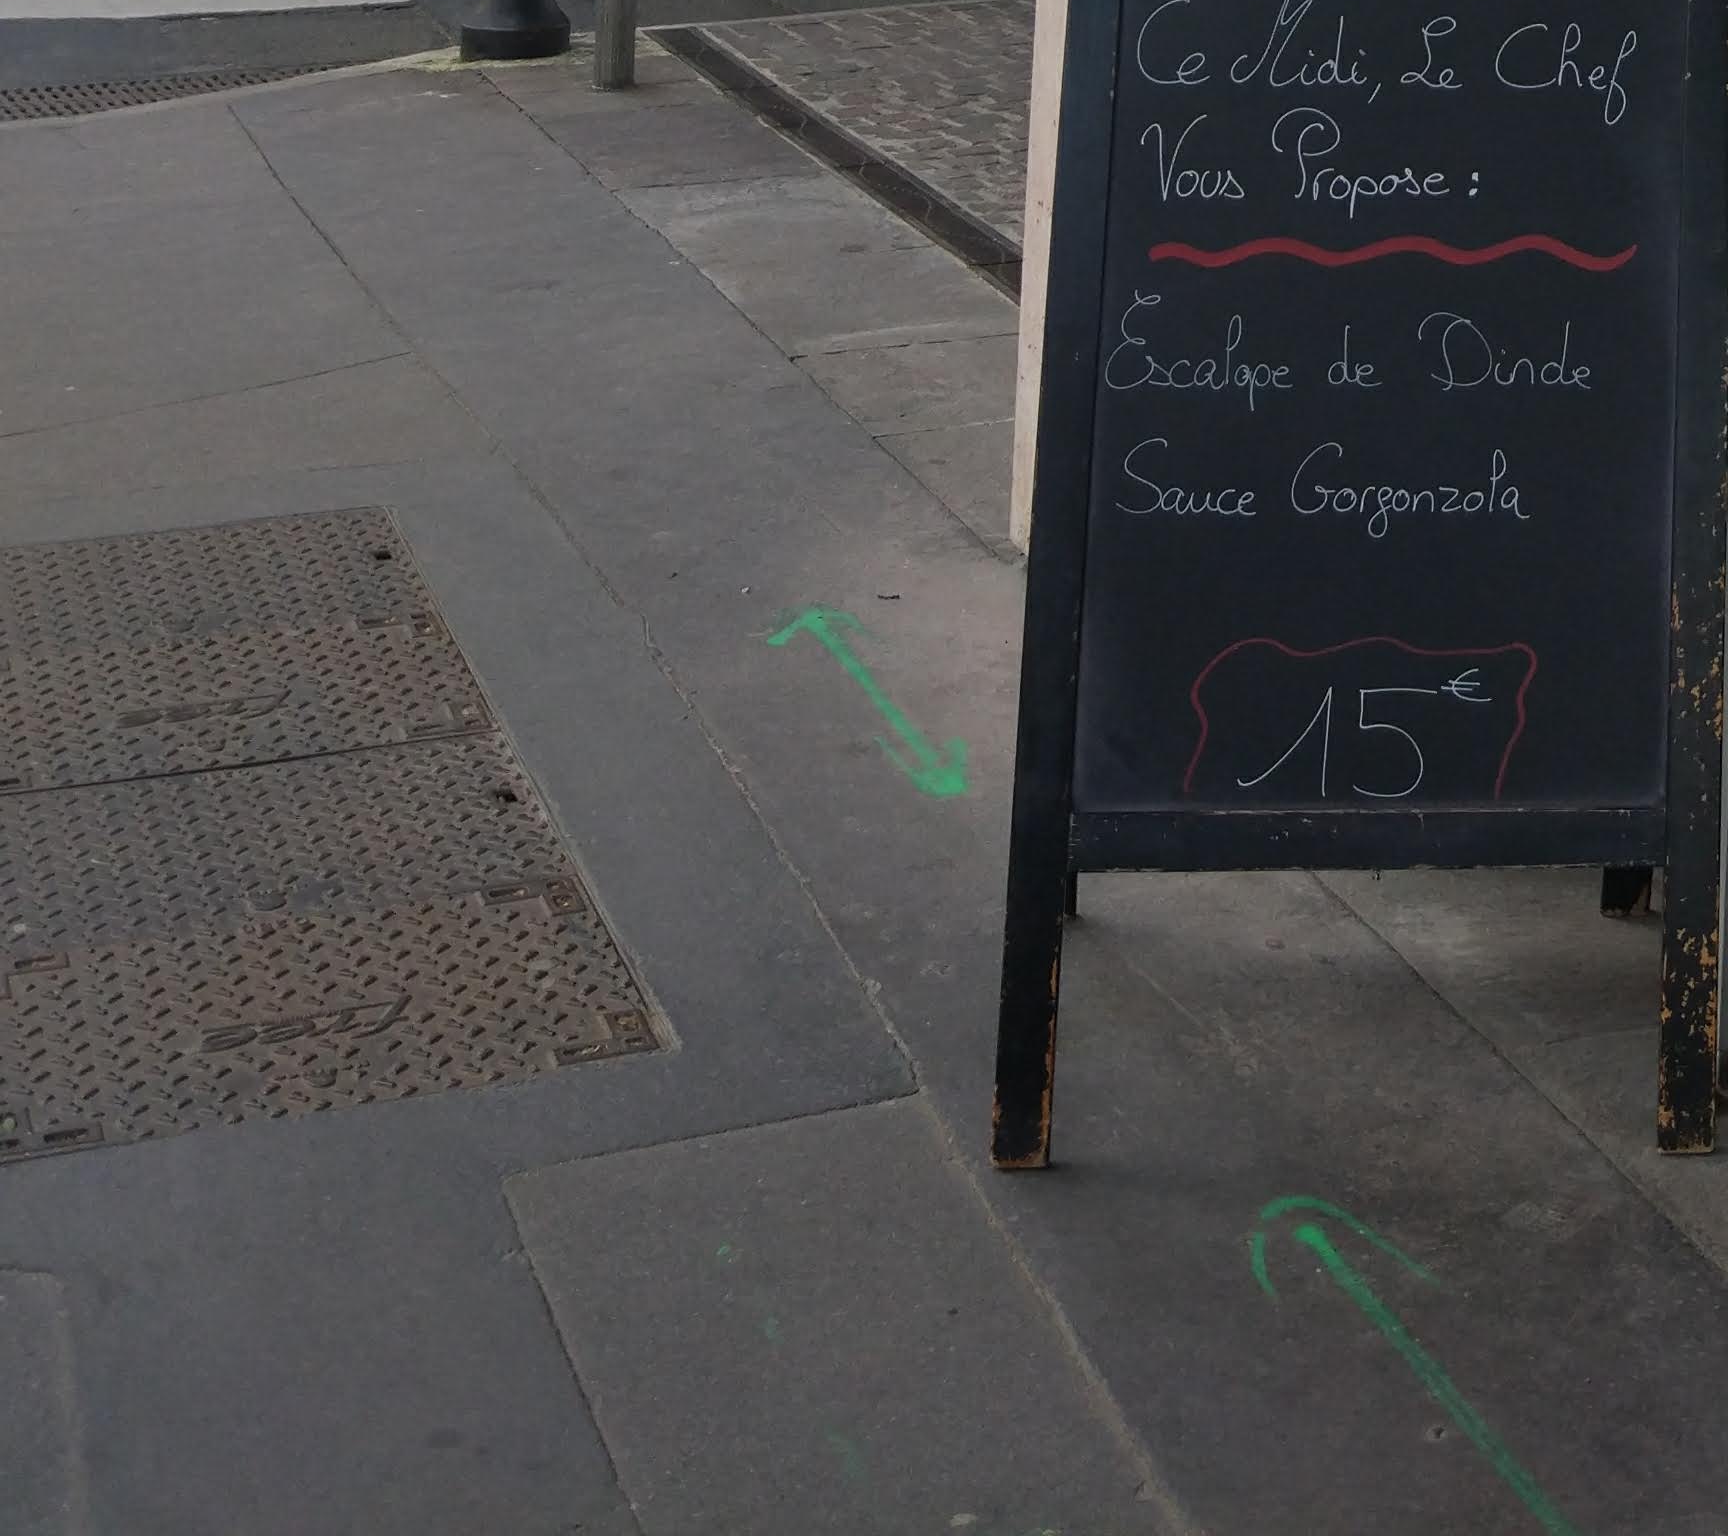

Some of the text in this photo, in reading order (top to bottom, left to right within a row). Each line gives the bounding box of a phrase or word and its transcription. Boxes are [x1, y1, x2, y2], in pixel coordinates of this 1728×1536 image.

[1399, 15, 1463, 89] Le
[1495, 22, 1637, 126] Chef
[1140, 113, 1246, 202] Vous
[1104, 289, 1592, 412] Escalope de Dinde
[1115, 437, 1531, 539] Sauce Gorgonzola
